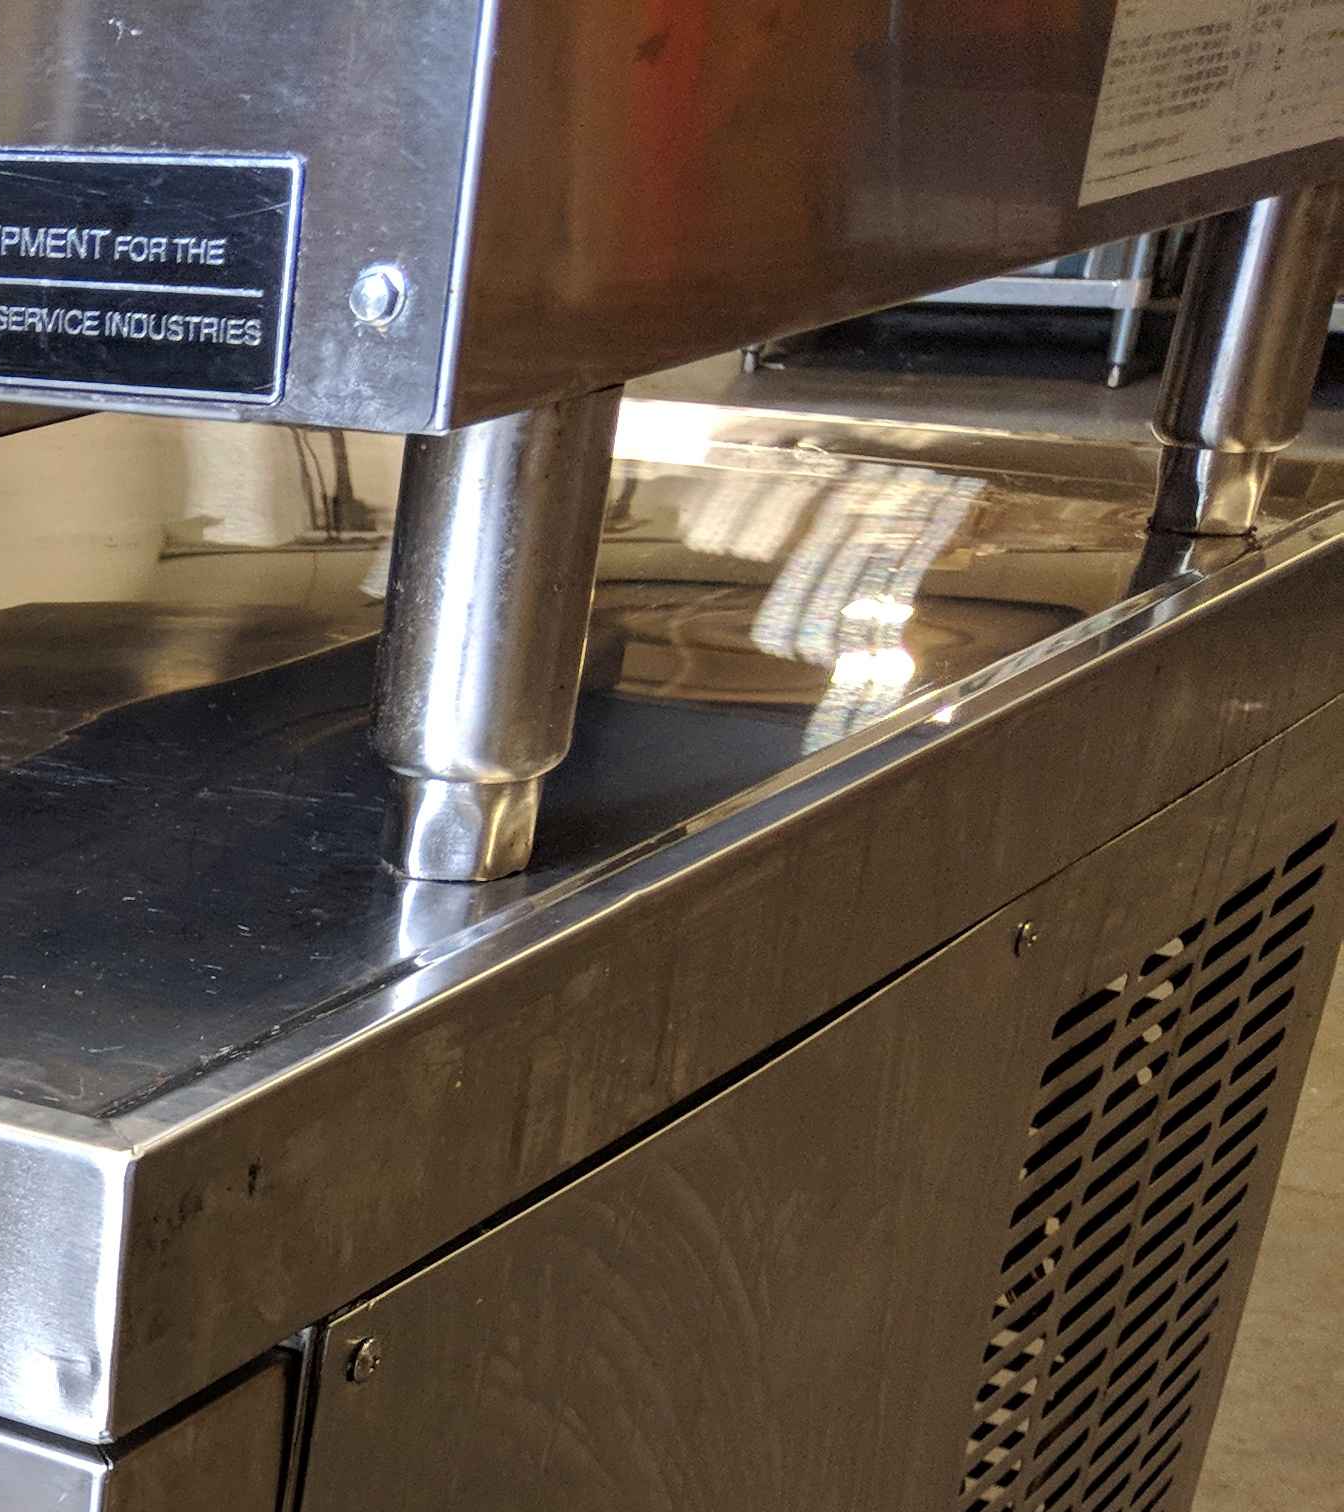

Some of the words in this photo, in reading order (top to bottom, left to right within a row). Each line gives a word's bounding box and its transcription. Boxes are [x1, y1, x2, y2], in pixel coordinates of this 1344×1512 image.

[113, 235, 168, 264] FOR
[174, 237, 228, 266] THE
[104, 311, 263, 347] INDUSTRIES
